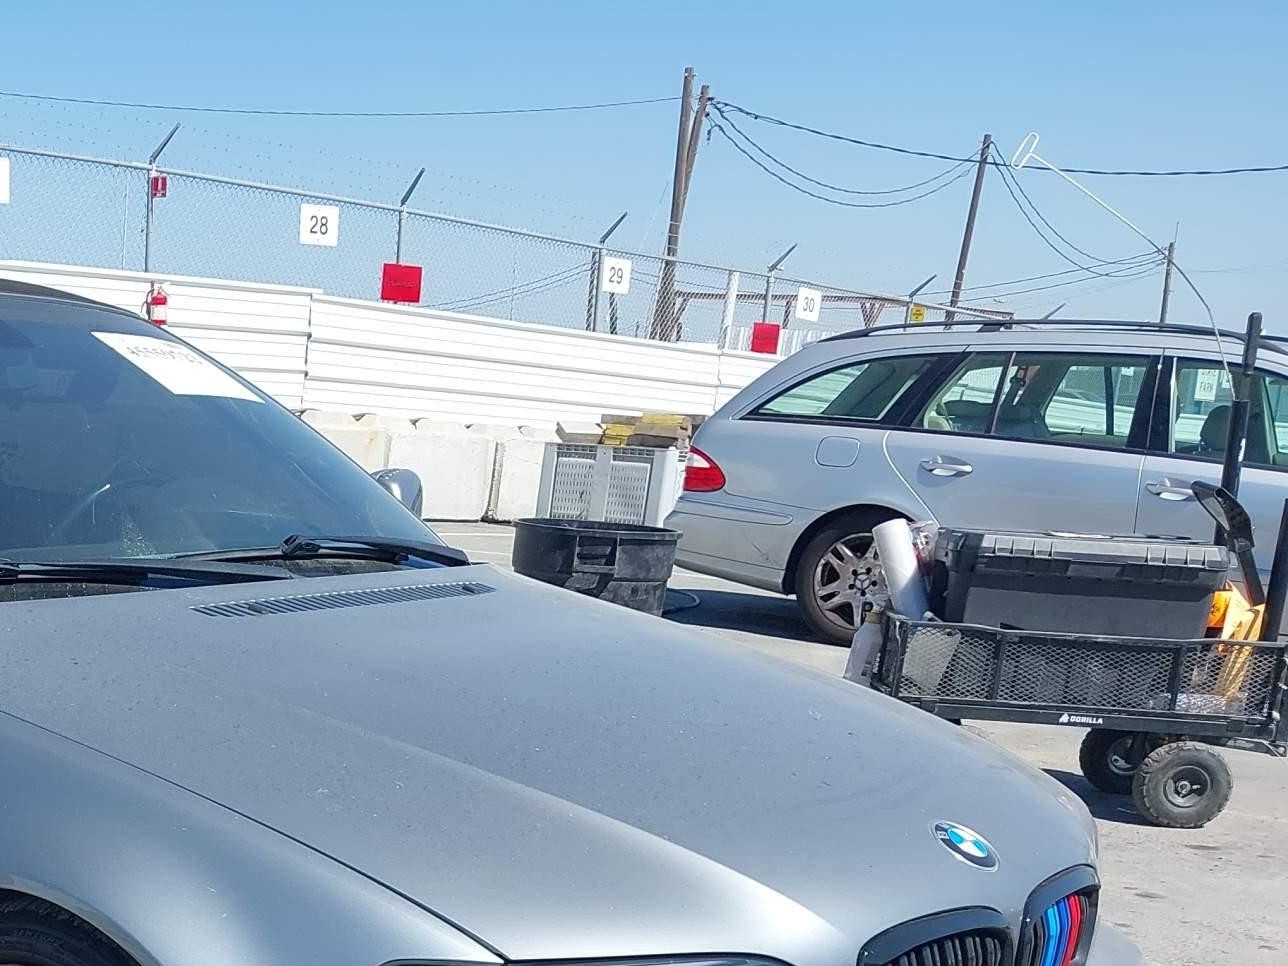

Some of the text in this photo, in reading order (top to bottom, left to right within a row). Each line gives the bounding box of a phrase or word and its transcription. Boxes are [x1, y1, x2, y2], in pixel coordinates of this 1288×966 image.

[309, 214, 329, 236] 28
[608, 266, 624, 285] 29
[802, 296, 816, 313] 30
[1070, 716, 1103, 724] GORILLA
